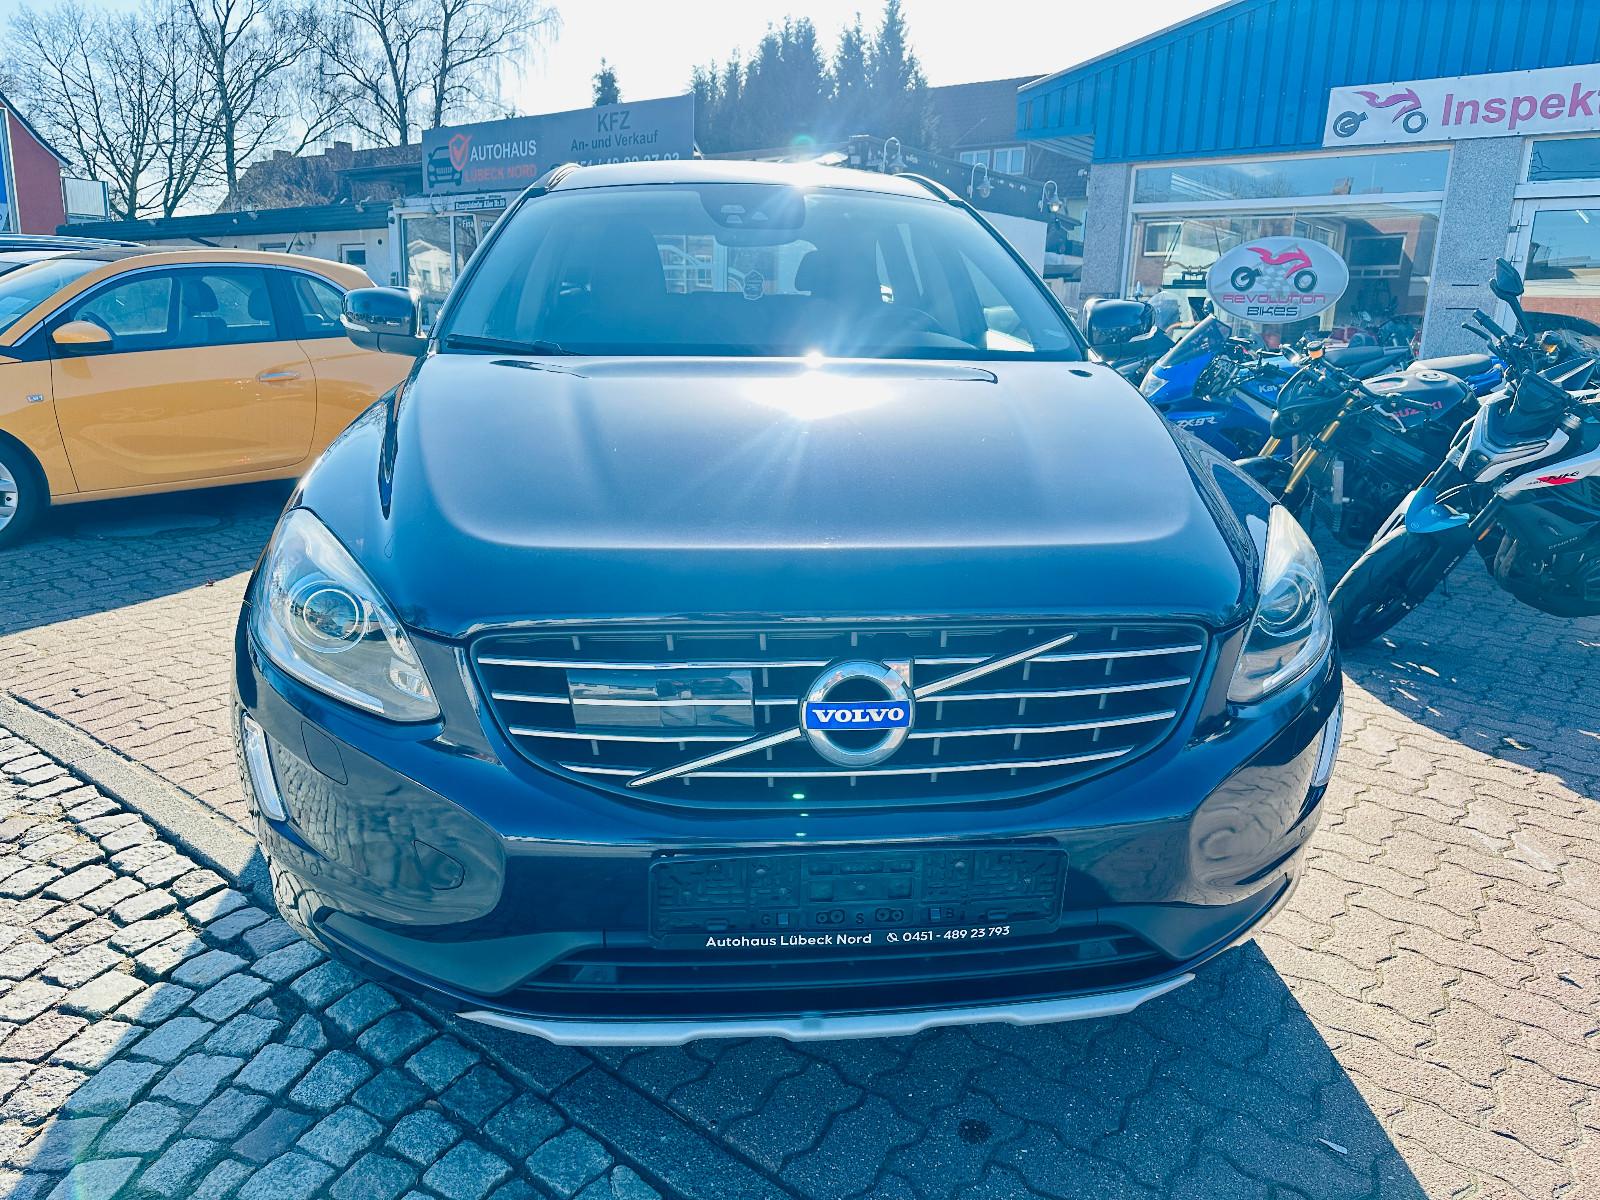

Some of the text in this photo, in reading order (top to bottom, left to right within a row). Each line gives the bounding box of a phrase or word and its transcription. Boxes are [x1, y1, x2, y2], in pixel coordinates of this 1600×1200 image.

[1441, 82, 1600, 130] Inspek
[597, 110, 631, 132] KFZ
[469, 139, 537, 162] AUTOHAUS
[570, 129, 659, 152] An- und Verkauf
[509, 163, 537, 178] NORD
[811, 707, 905, 723] VOLVO
[706, 935, 777, 947] Autohaus
[780, 934, 833, 946] Lübeck
[836, 932, 872, 945] Nord
[902, 930, 933, 942] 0451
[943, 929, 968, 940] 489
[970, 927, 986, 938] 23
[988, 925, 1010, 937] 793
